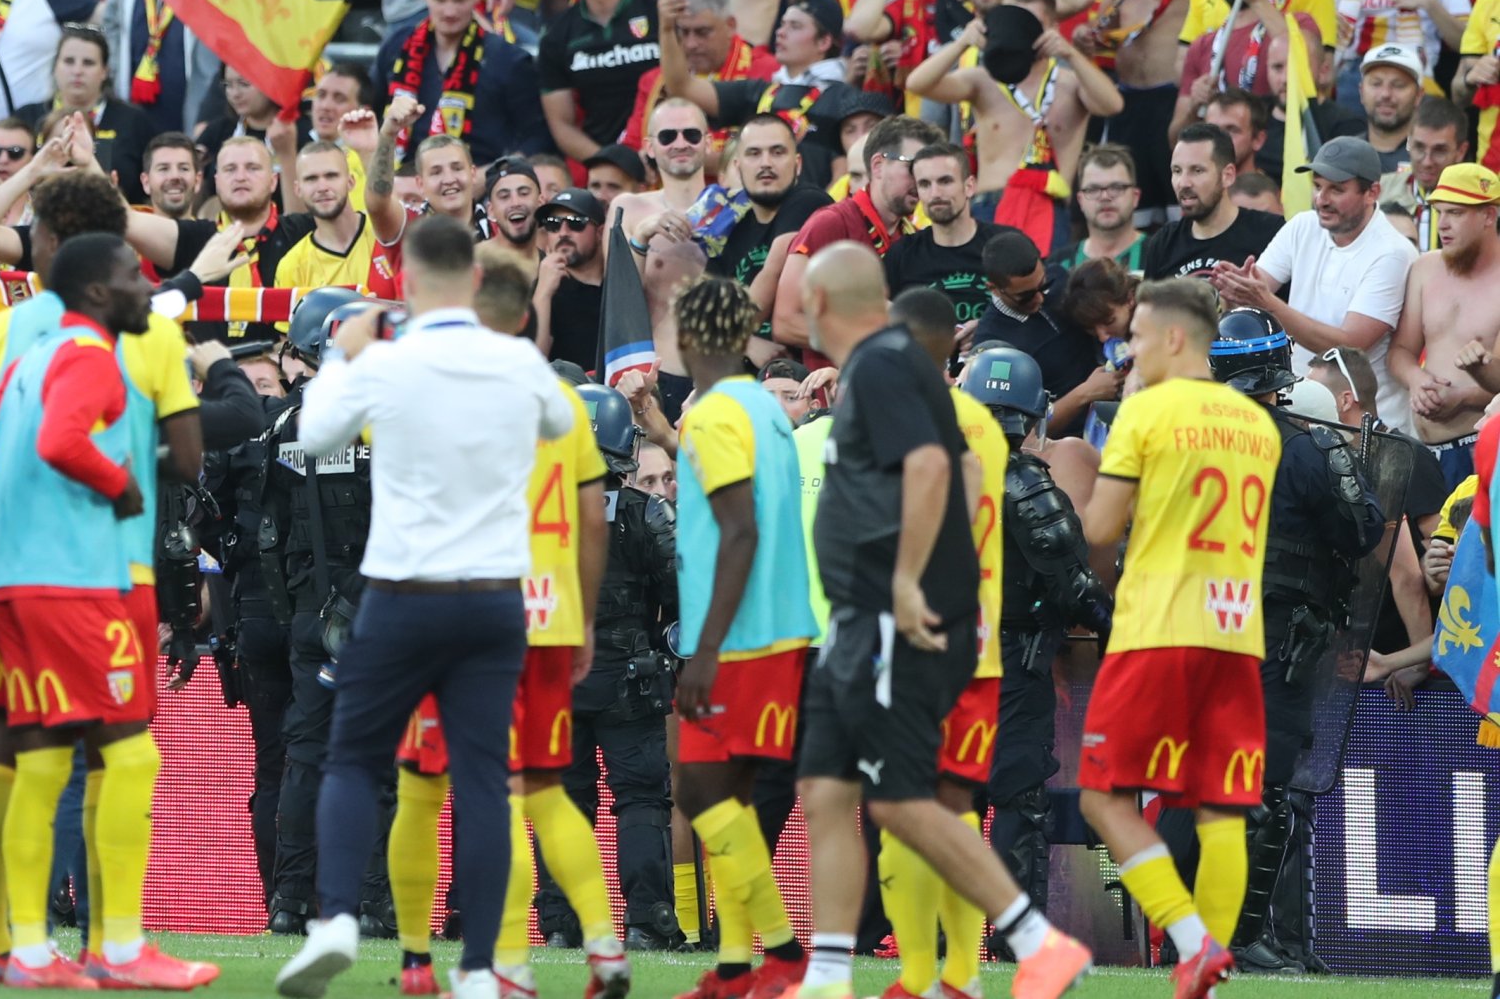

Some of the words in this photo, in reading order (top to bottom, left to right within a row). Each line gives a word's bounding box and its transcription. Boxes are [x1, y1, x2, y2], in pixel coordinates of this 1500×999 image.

[571, 43, 661, 70] Auchan
[532, 462, 570, 549] 4
[1188, 467, 1267, 559] 29
